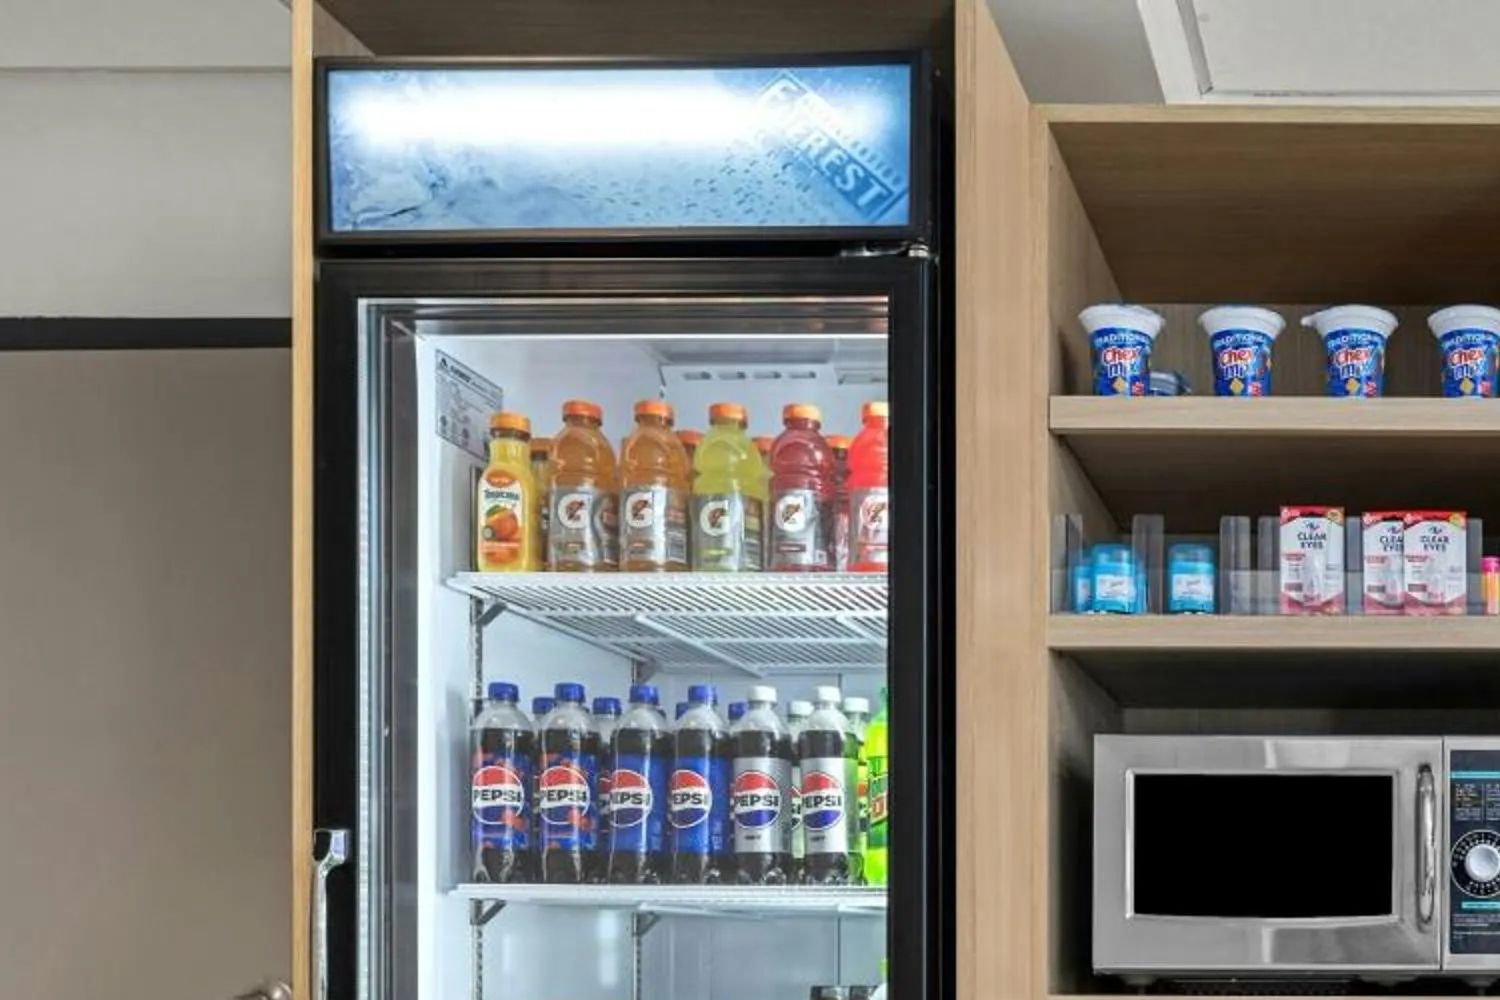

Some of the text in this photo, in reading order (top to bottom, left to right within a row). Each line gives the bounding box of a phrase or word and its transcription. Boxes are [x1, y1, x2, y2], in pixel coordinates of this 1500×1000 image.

[1379, 535, 1404, 544] CLEA
[610, 791, 650, 805] EPSI
[671, 793, 707, 806] EPSI
